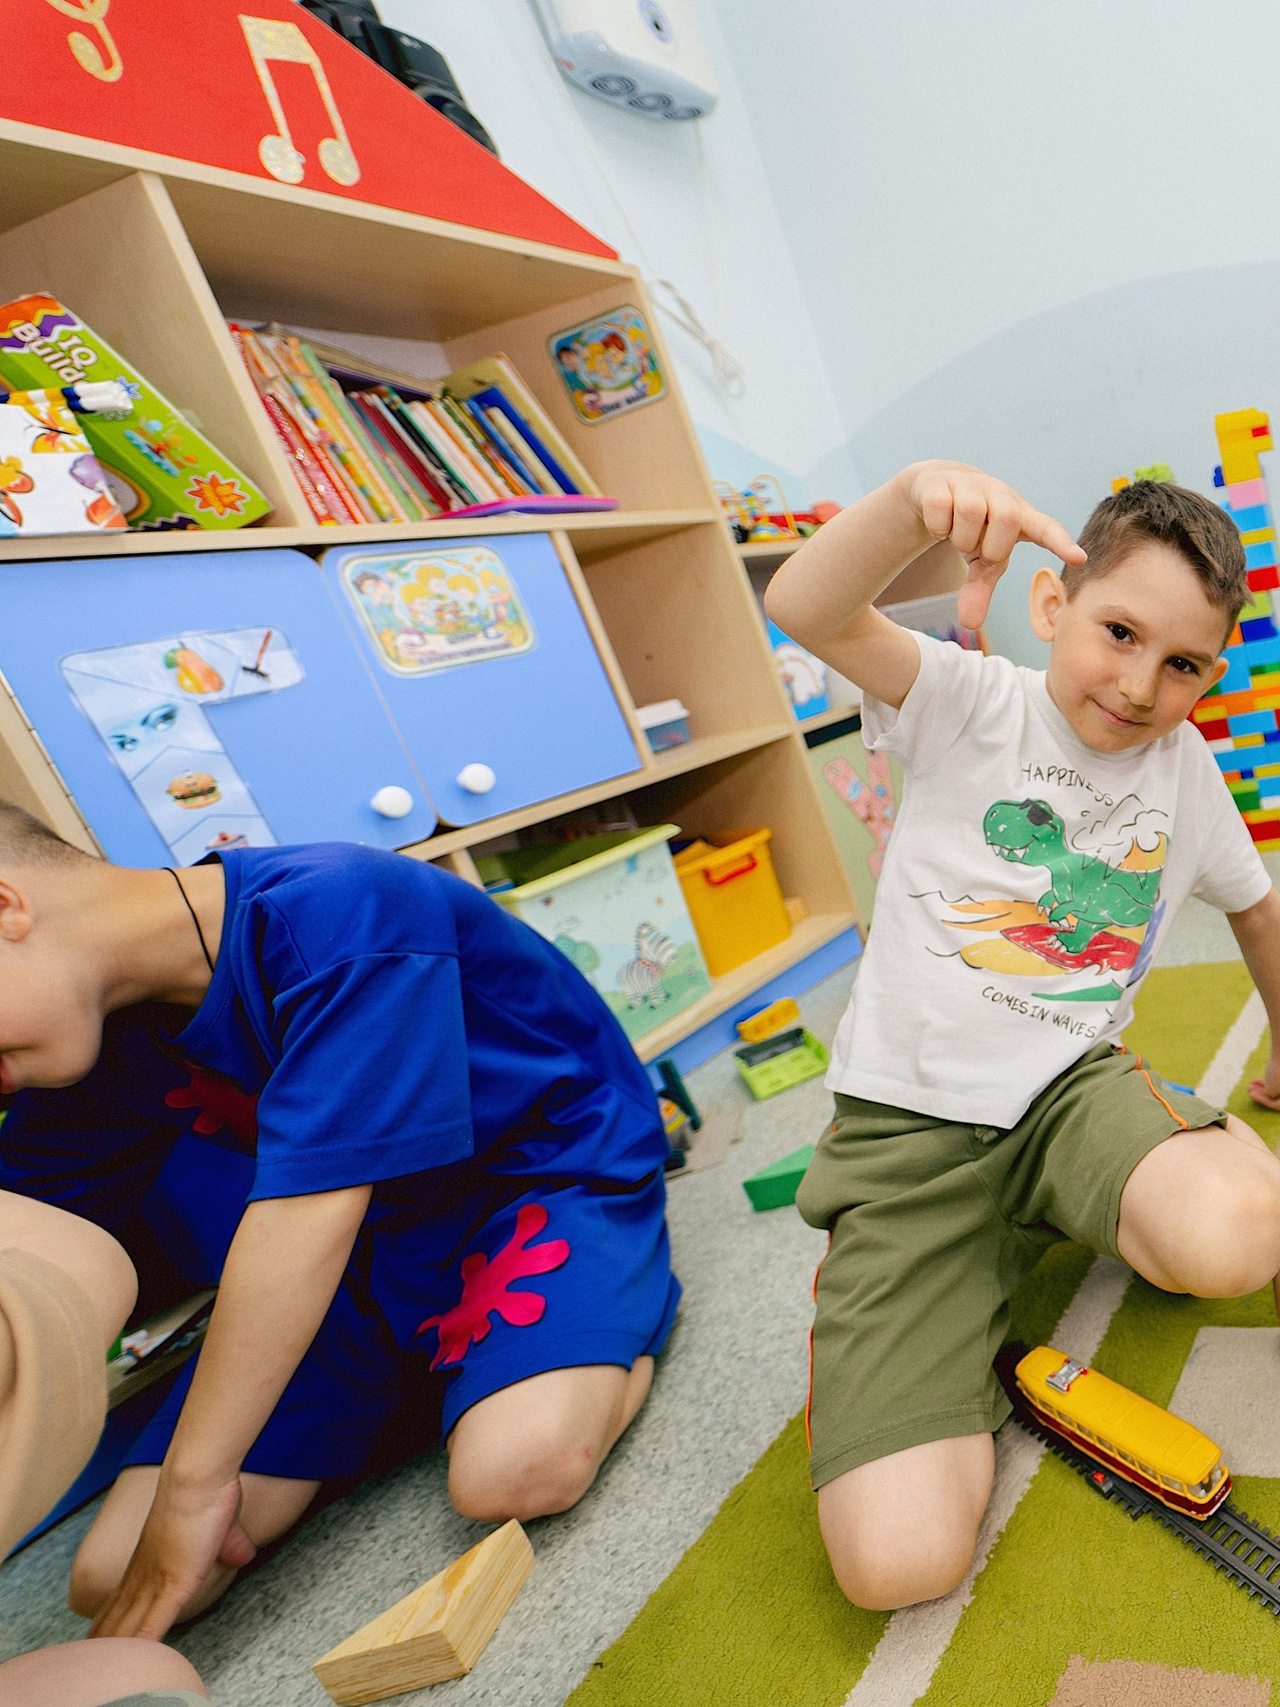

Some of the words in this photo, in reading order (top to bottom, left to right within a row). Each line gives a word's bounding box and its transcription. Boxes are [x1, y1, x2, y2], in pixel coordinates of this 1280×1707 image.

[57, 335, 98, 370] IQ
[981, 986, 1028, 1014] COMES
[1029, 1005, 1050, 1021] IN
[1052, 1012, 1097, 1038] WAVES
